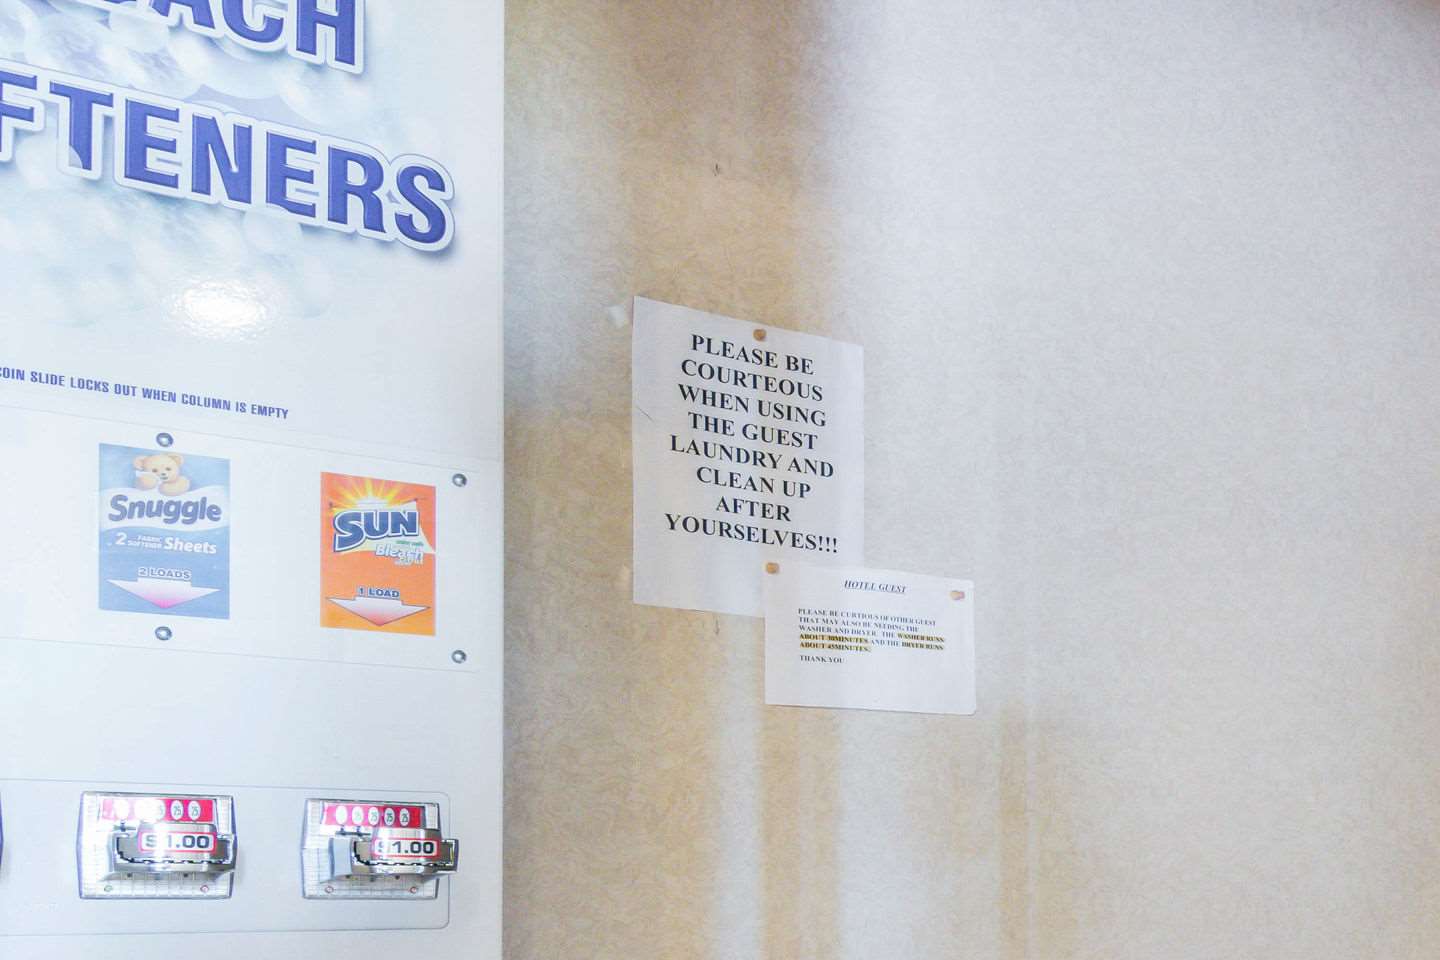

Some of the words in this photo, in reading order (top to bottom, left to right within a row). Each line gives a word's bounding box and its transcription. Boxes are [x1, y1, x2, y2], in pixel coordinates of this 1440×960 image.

[105, 0, 356, 66] CH
[691, 334, 778, 369] PLEASE
[785, 354, 815, 376] BE
[30, 371, 65, 386] SLIDE
[70, 377, 109, 393] LOCKS
[114, 383, 137, 397] OUT
[141, 387, 177, 403] WHEN
[181, 394, 231, 411] COLUMN
[235, 401, 247, 413] IS
[250, 404, 289, 419] EMPTY
[681, 359, 824, 402] COURTEOUS
[678, 383, 750, 413] WHEN
[757, 399, 826, 427] USING
[688, 411, 735, 437] THE
[742, 423, 818, 450] GUEST
[670, 434, 782, 469] LAUNDRY
[787, 457, 834, 478] AND
[696, 466, 775, 494] CLEAN
[783, 480, 811, 499] UP
[108, 494, 222, 525] Snuggle
[716, 496, 791, 522] AFTER
[115, 532, 127, 545] 2
[163, 536, 217, 554] Sheets
[333, 510, 419, 553] SUN
[665, 513, 838, 553] YOURSELVES!!!
[139, 567, 148, 576] 2
[150, 568, 192, 579] LOADS
[844, 580, 876, 591] HOTEL
[878, 583, 907, 595] GUEST
[359, 587, 365, 596] 1
[368, 588, 400, 598] LOAD
[798, 608, 826, 616] PLEASE
[799, 624, 832, 633] WASHER
[799, 633, 825, 641] ABOUT
[800, 655, 826, 663] THANK
